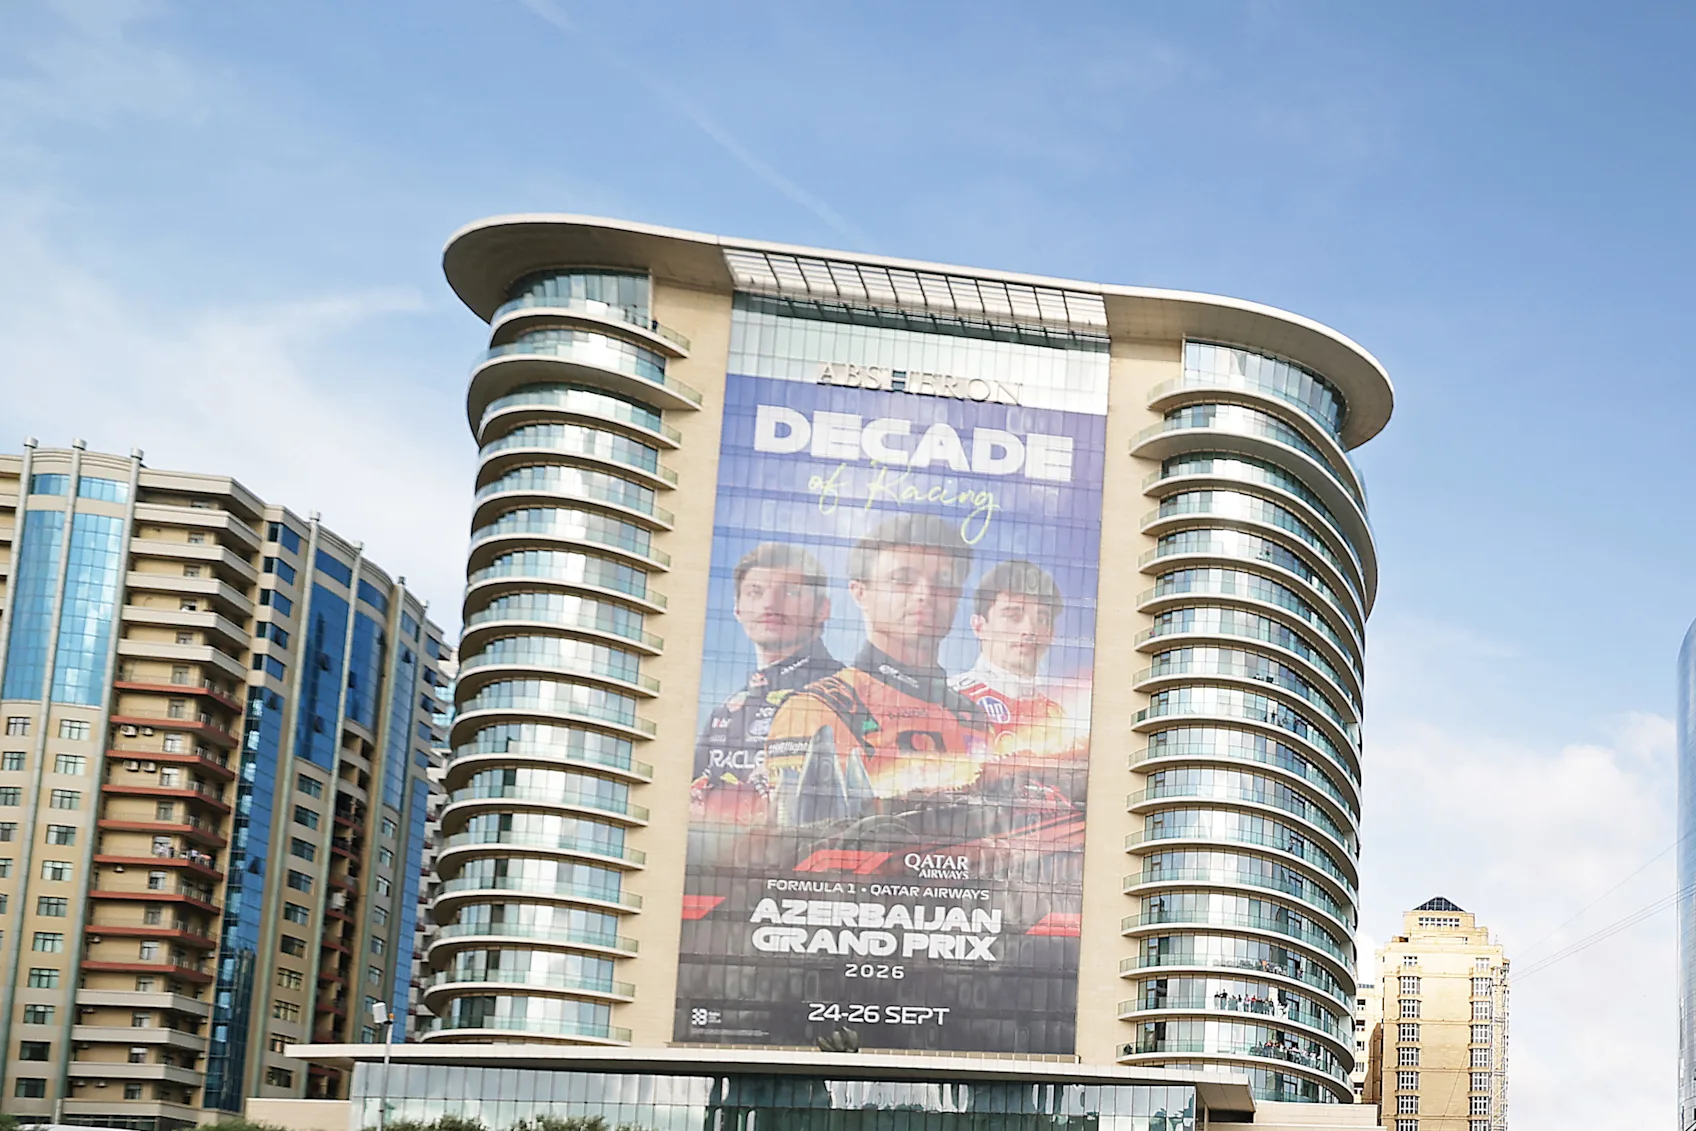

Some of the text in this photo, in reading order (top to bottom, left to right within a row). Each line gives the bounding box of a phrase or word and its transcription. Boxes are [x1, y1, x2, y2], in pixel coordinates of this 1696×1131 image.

[816, 361, 1024, 405] ABSHERON
[753, 404, 1074, 482] DECADE
[808, 462, 1000, 544] of Racing
[904, 853, 969, 870] QATAR
[918, 869, 969, 880] AIRWAYS
[767, 879, 990, 900] FORMULA 1 QATAR AIRWAYS
[750, 897, 1002, 934] AZERBAIJAN
[751, 926, 997, 961] GRAND PRIX
[844, 963, 905, 979] 2026
[808, 1003, 950, 1025] 24-26 SEPT
